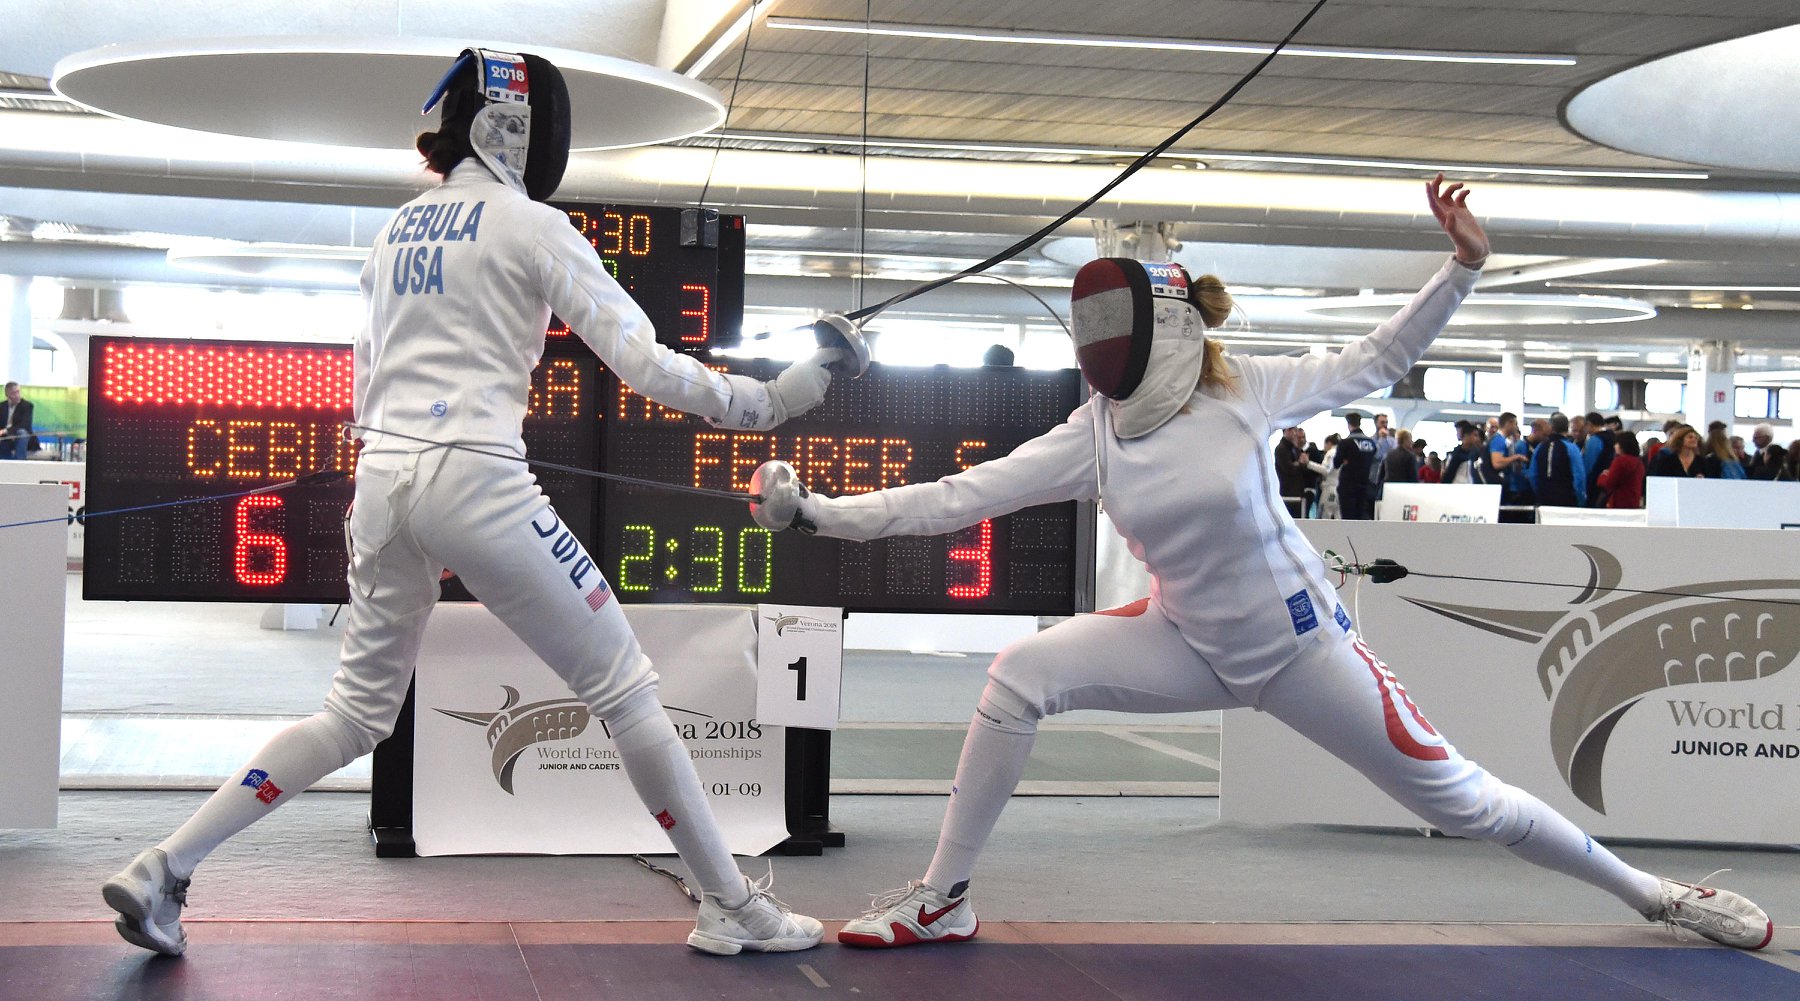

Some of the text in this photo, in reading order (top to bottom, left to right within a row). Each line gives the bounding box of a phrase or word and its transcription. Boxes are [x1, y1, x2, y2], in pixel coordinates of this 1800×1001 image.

[491, 65, 525, 82] 2018
[387, 201, 486, 245] CEBULA
[393, 246, 444, 296] USA
[1149, 266, 1181, 278] 2018
[681, 284, 709, 342] 3
[693, 432, 914, 492] FEHRER
[235, 495, 288, 585] 6
[531, 505, 596, 590] USA
[620, 525, 773, 594] 2:30
[787, 656, 807, 701] 1
[705, 719, 762, 740] 2018
[1665, 699, 1787, 731] World
[536, 747, 579, 760] World
[538, 763, 620, 771] JUNIOR AND CADETS
[1670, 740, 1800, 759] JUNIOR AND
